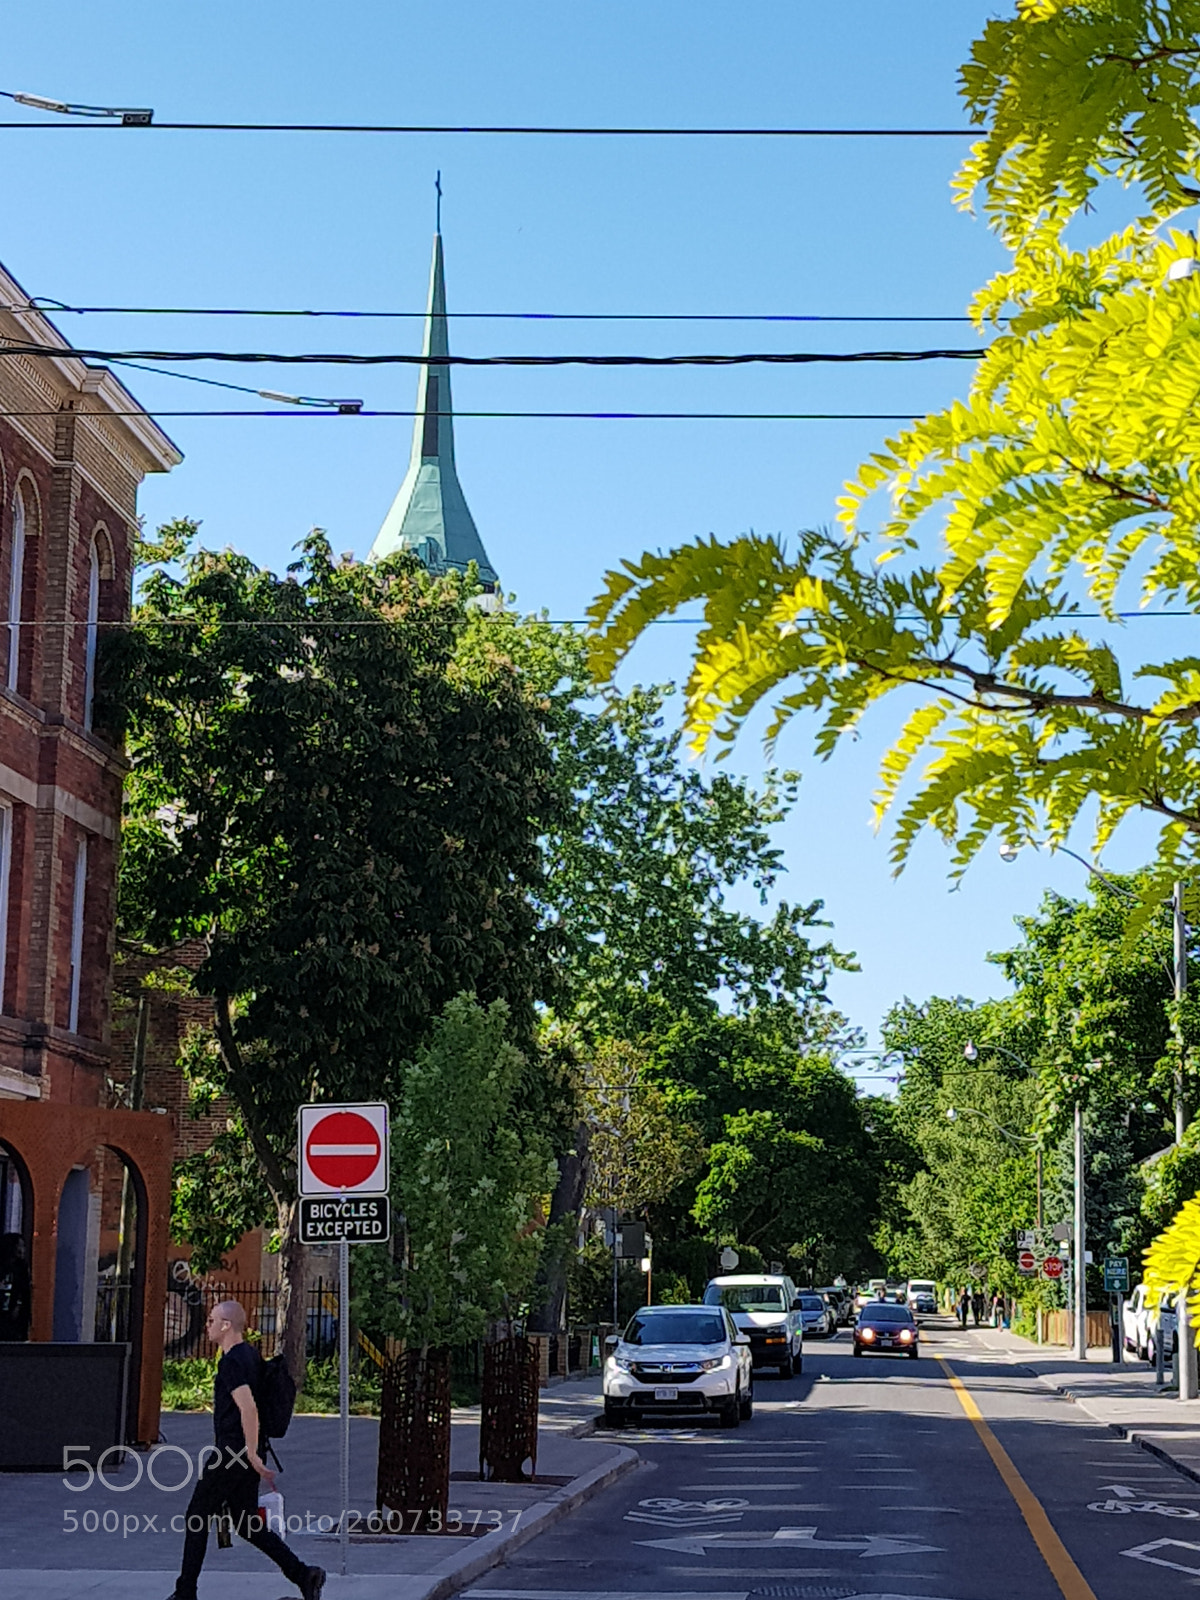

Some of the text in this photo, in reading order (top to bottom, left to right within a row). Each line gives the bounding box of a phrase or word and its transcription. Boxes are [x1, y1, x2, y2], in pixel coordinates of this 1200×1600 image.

[310, 1202, 378, 1218] BICYCLES
[306, 1220, 382, 1237] EXCEPTED
[1043, 1262, 1063, 1272] STOP
[1108, 1260, 1123, 1268] PAY
